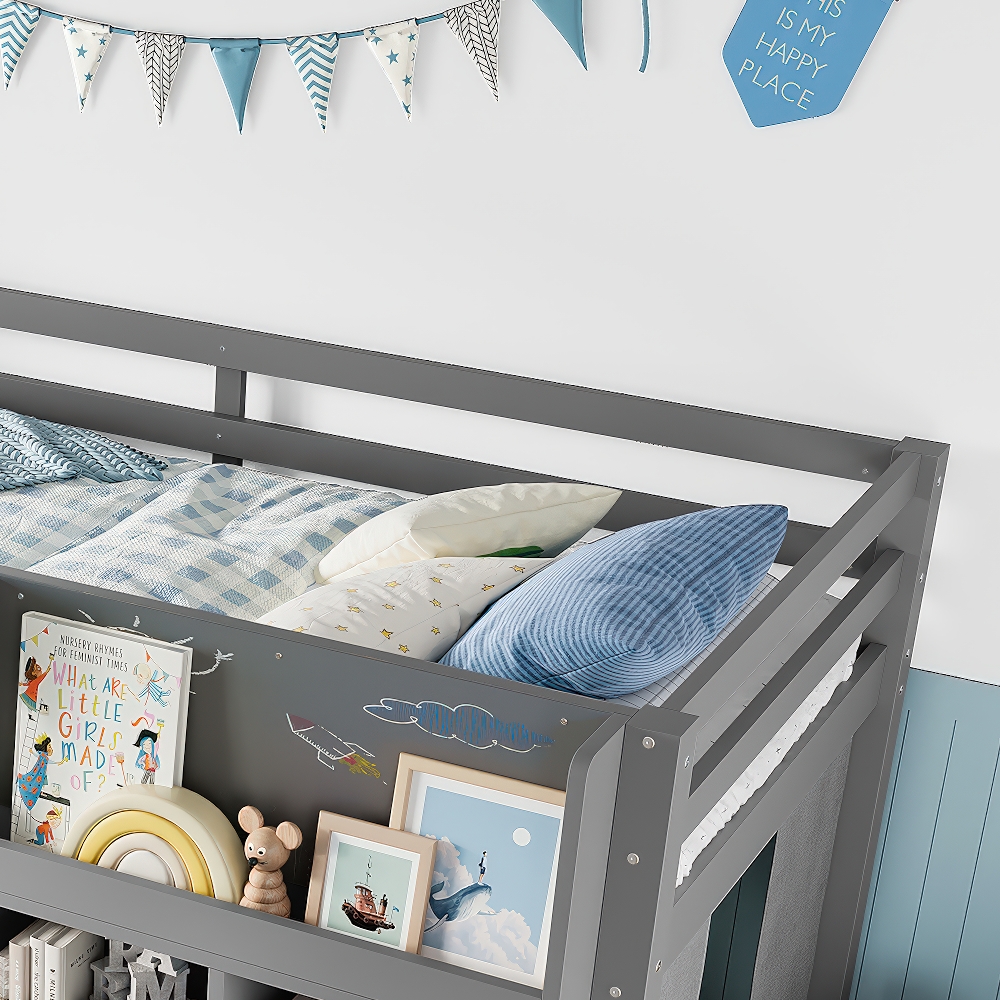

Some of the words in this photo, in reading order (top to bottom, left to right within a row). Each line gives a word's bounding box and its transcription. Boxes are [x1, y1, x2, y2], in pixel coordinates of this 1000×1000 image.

[776, 7, 798, 30] IS
[797, 17, 836, 47] MY
[755, 31, 828, 79] HAPPY
[738, 58, 815, 110] PLACE
[53, 645, 67, 659] FOR
[69, 649, 103, 667] FEMINIST
[106, 657, 129, 673] TIMES
[59, 634, 93, 653] NURSERY
[94, 642, 124, 658] RHYMES
[102, 676, 128, 701] ARE
